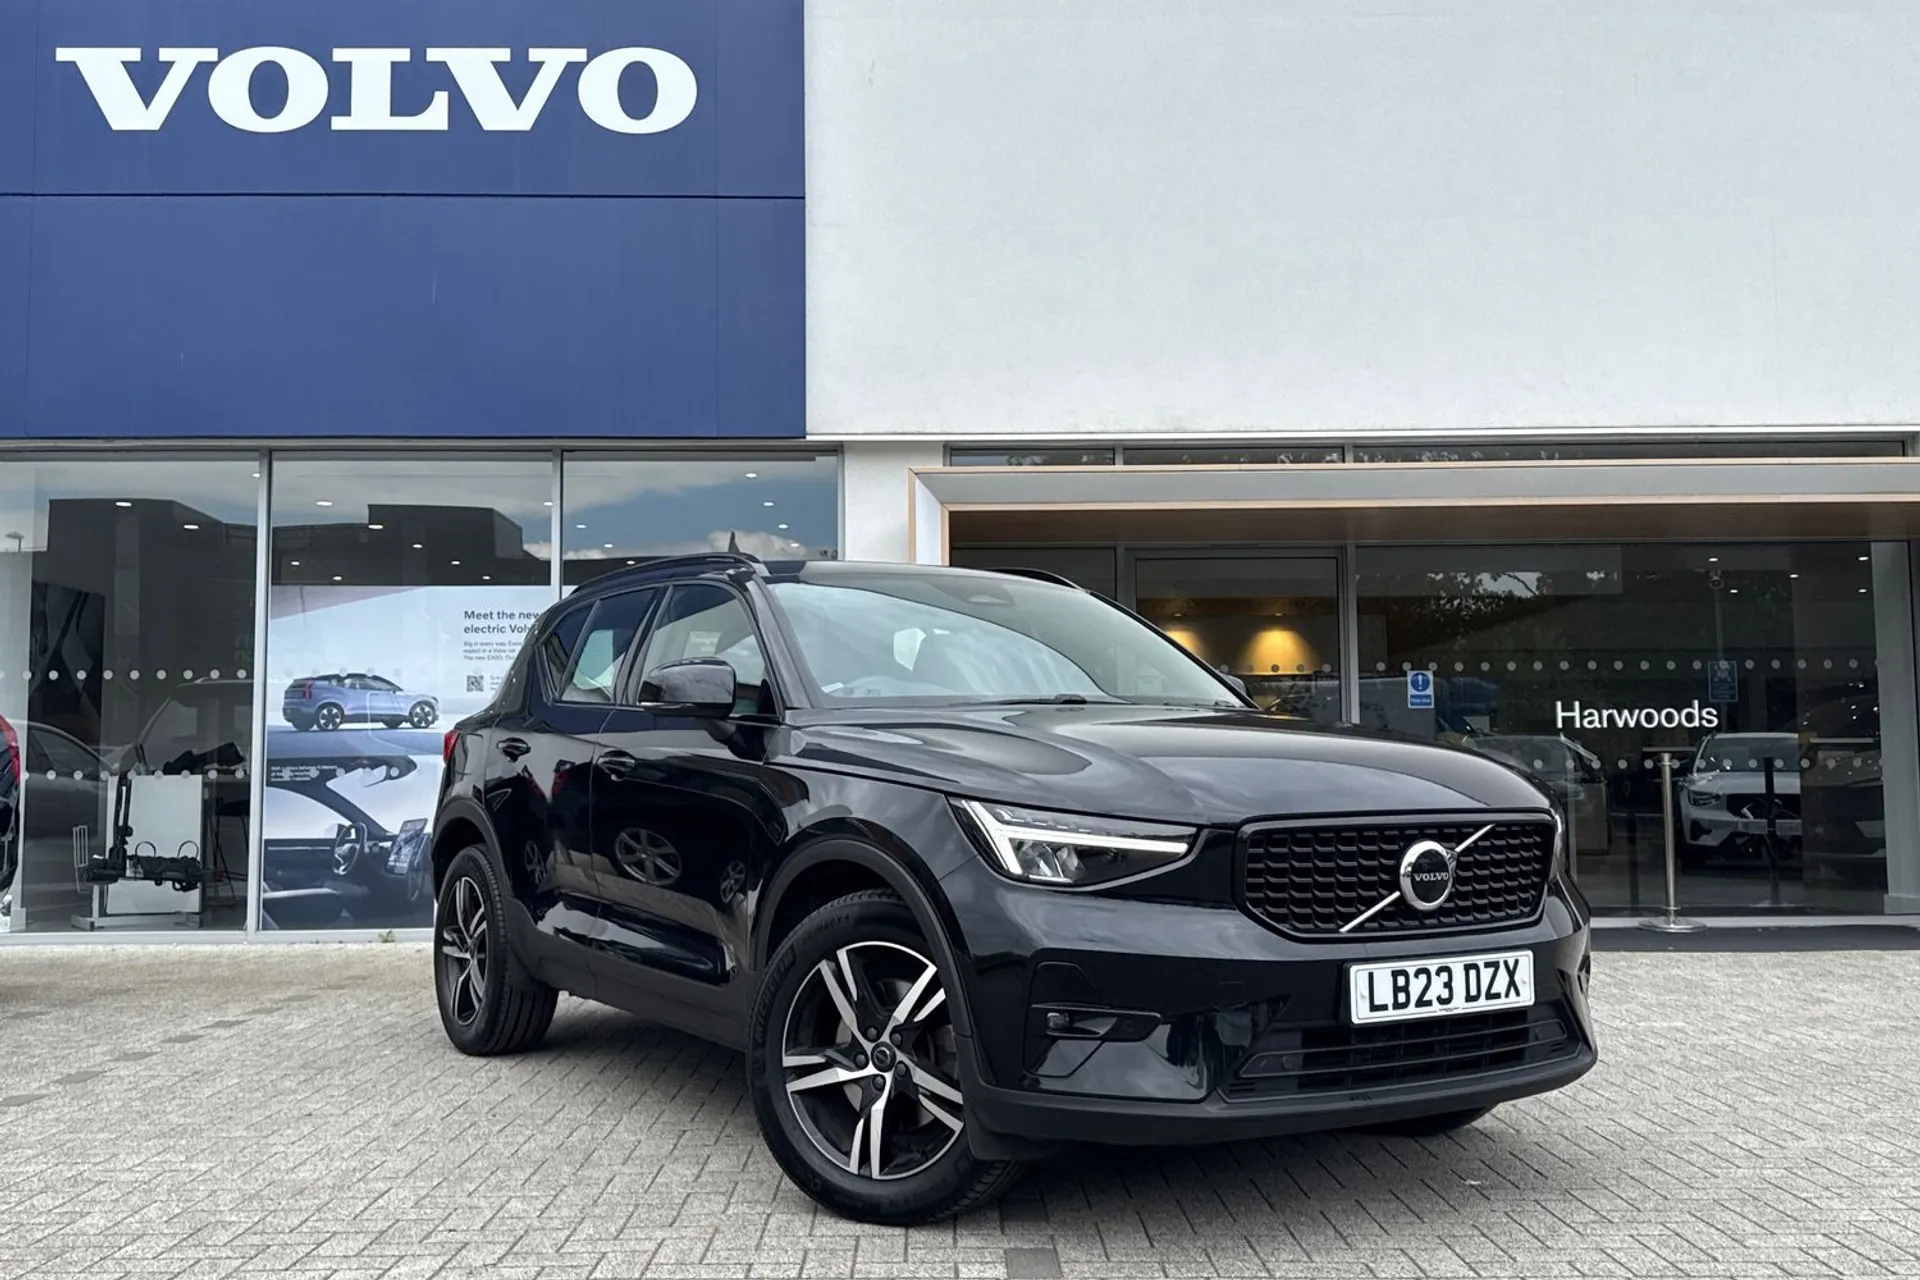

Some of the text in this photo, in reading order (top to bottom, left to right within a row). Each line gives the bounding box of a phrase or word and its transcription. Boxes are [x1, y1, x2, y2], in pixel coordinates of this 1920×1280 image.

[56, 46, 697, 134] VOLVO
[464, 610, 494, 620] Meet
[497, 610, 516, 620] the
[463, 623, 507, 634] electric
[1555, 699, 1719, 729] Harwoods
[1412, 871, 1449, 882] VOLVO
[1367, 957, 1521, 1013] LB23 DZX
